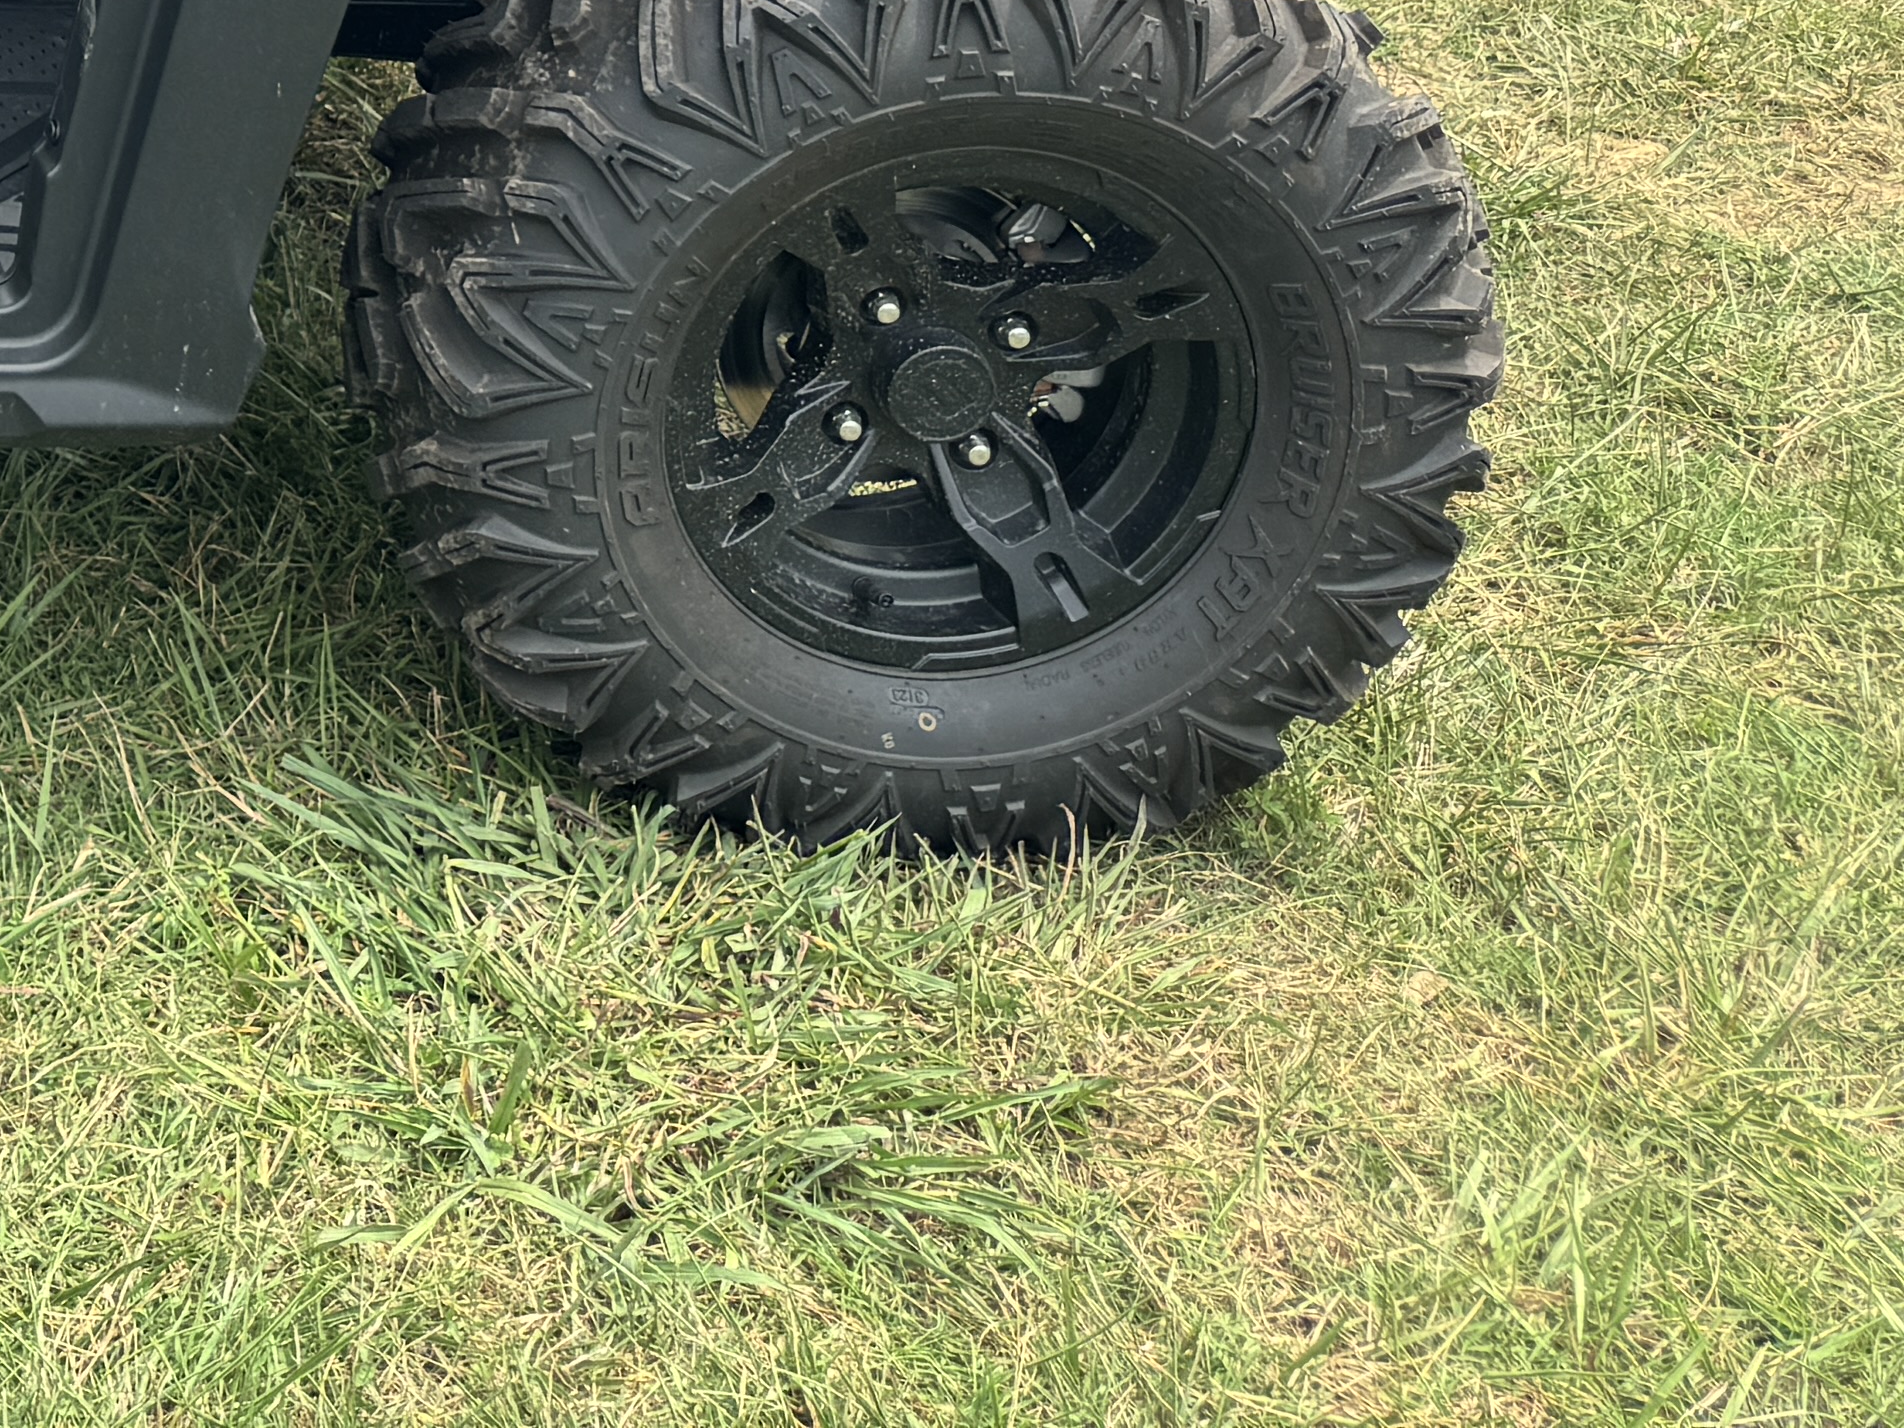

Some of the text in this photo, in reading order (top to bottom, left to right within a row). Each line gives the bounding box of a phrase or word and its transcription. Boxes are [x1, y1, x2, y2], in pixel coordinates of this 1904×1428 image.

[615, 254, 713, 528] ARISUN
[1196, 280, 1335, 641] BRUISER XAT
